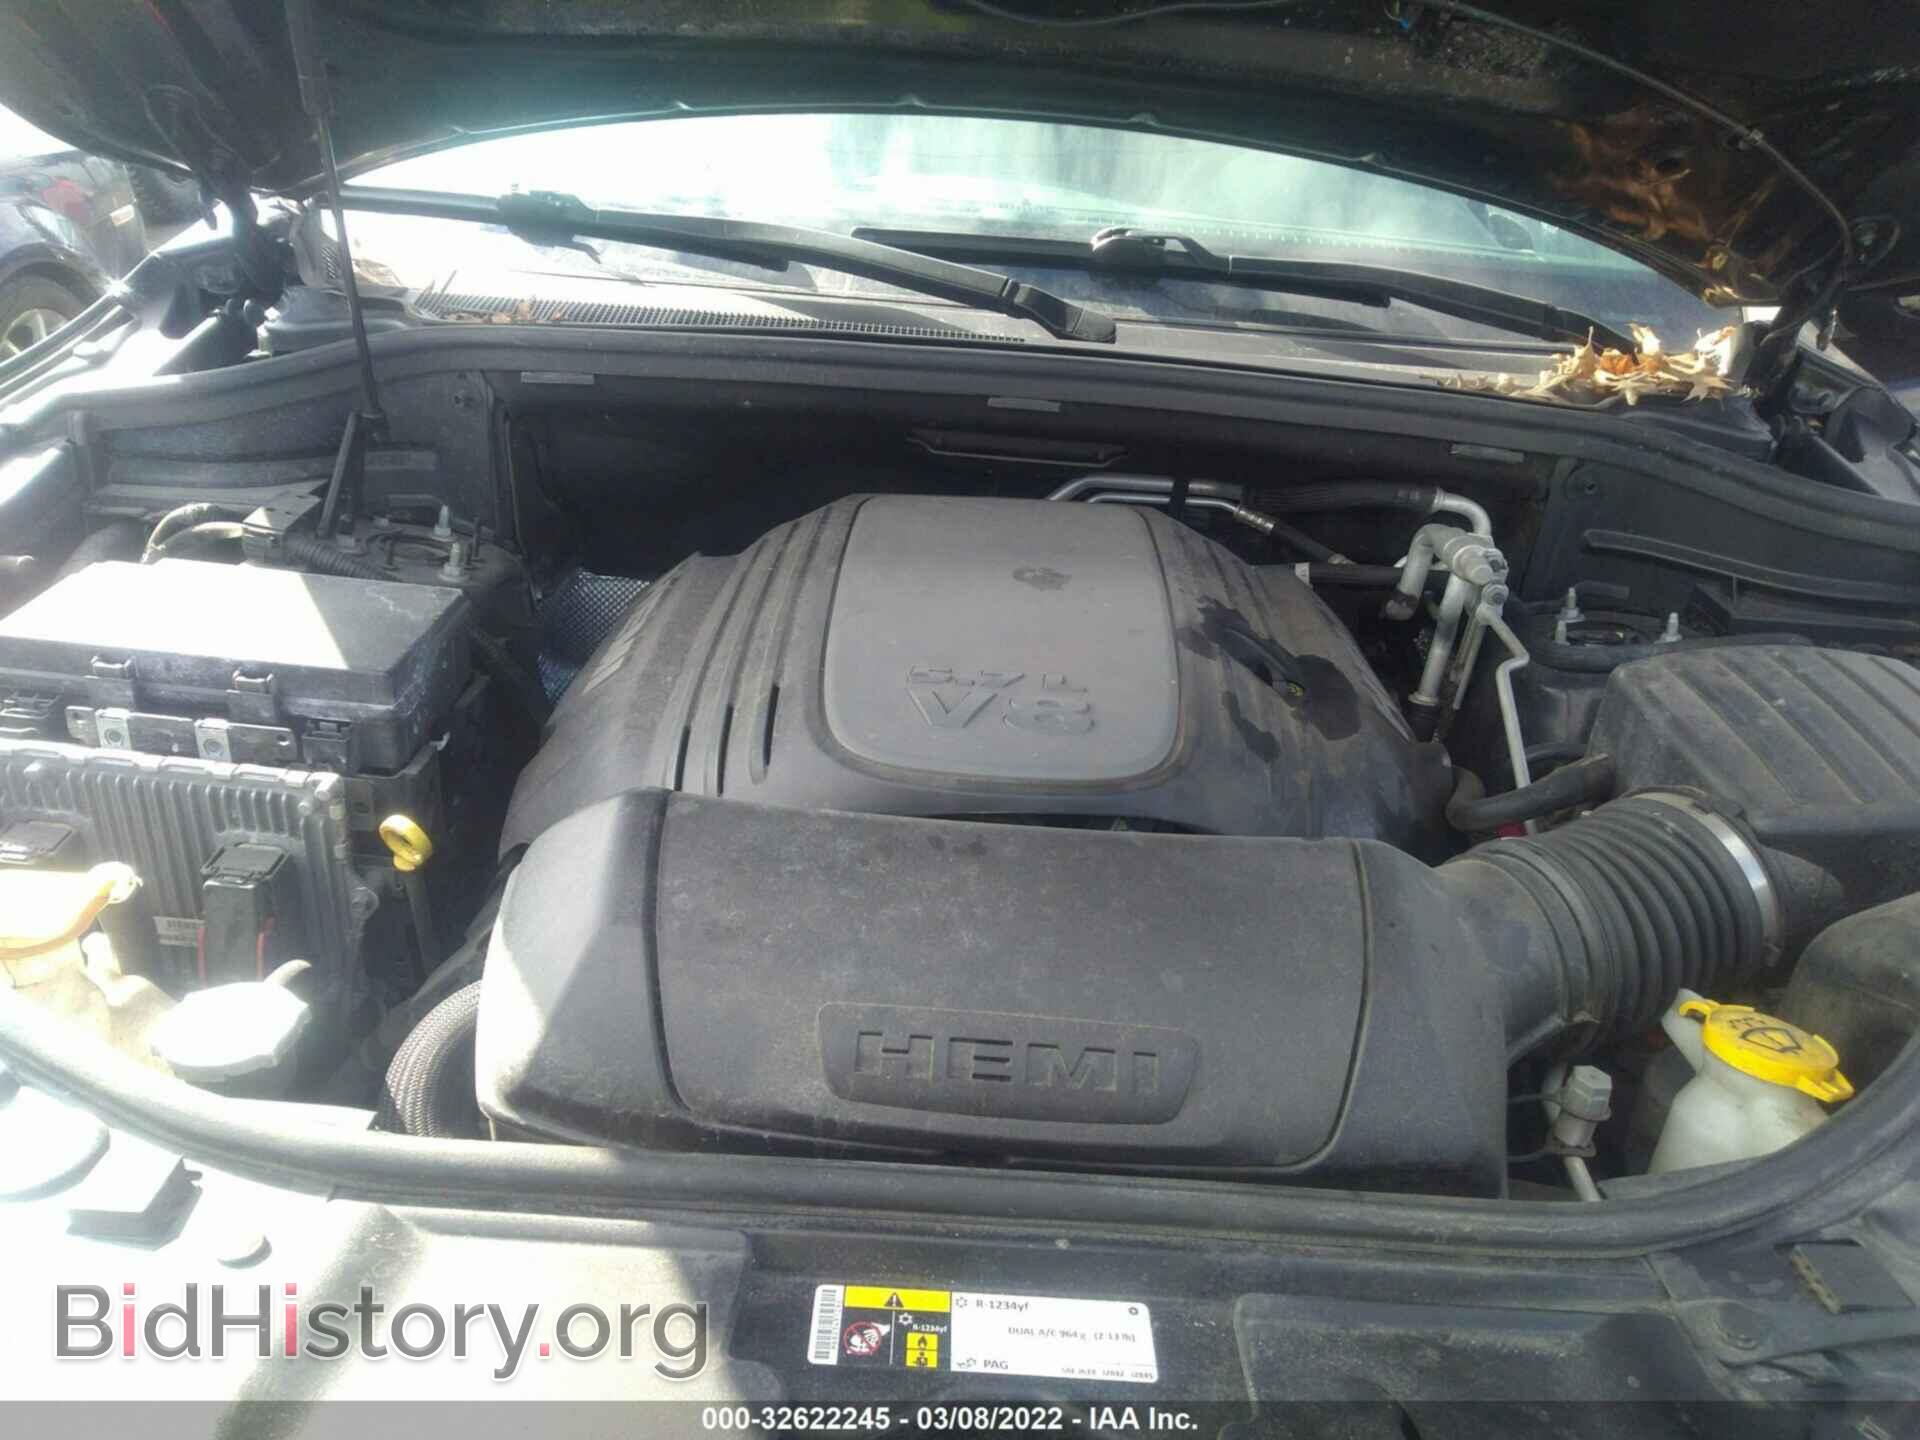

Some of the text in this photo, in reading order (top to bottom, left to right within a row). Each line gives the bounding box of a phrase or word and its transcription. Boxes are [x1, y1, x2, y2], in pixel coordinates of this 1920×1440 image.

[905, 686, 1096, 735] V8
[853, 1030, 1159, 1094] HEMI
[976, 1299, 1030, 1313] R-1234yf
[984, 1359, 1009, 1370] PAG
